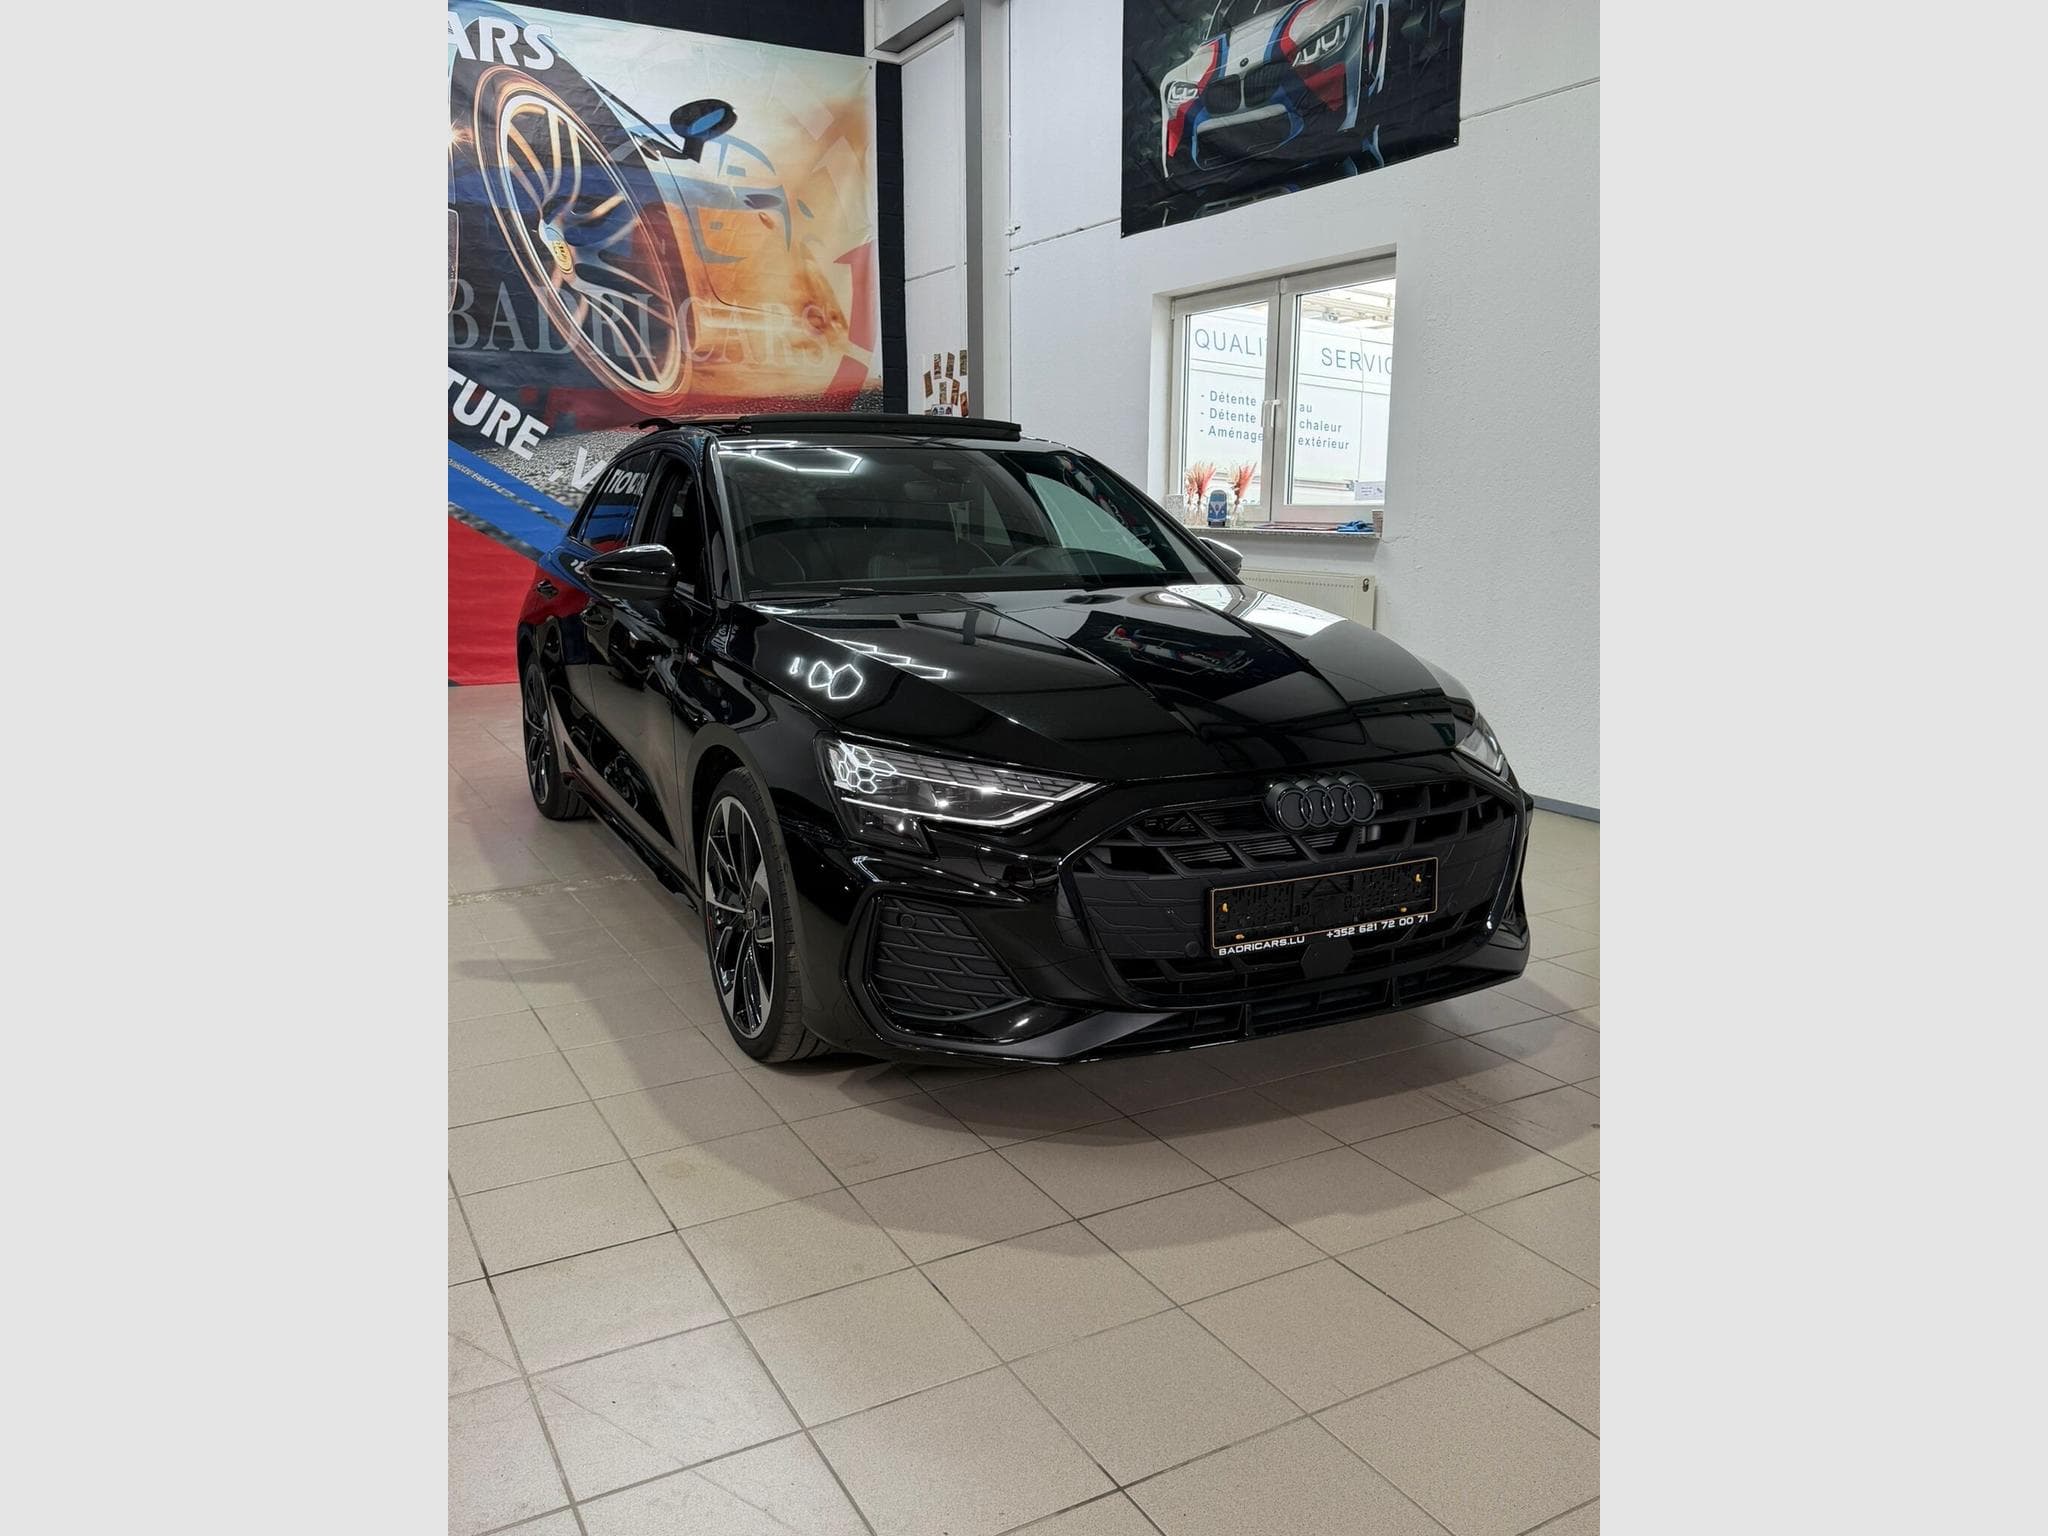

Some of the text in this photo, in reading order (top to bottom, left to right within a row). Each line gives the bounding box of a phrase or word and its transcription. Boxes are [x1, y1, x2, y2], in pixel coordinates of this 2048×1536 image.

[677, 296, 832, 368] CARS
[1195, 328, 1268, 357] QUALI
[1209, 390, 1257, 406] Détente
[1209, 407, 1257, 424] Détente
[1299, 419, 1343, 433] chaleur
[1297, 435, 1350, 450] extérieur
[1218, 914, 1429, 957] BADRICARS.LU +352 621 72 00 71
